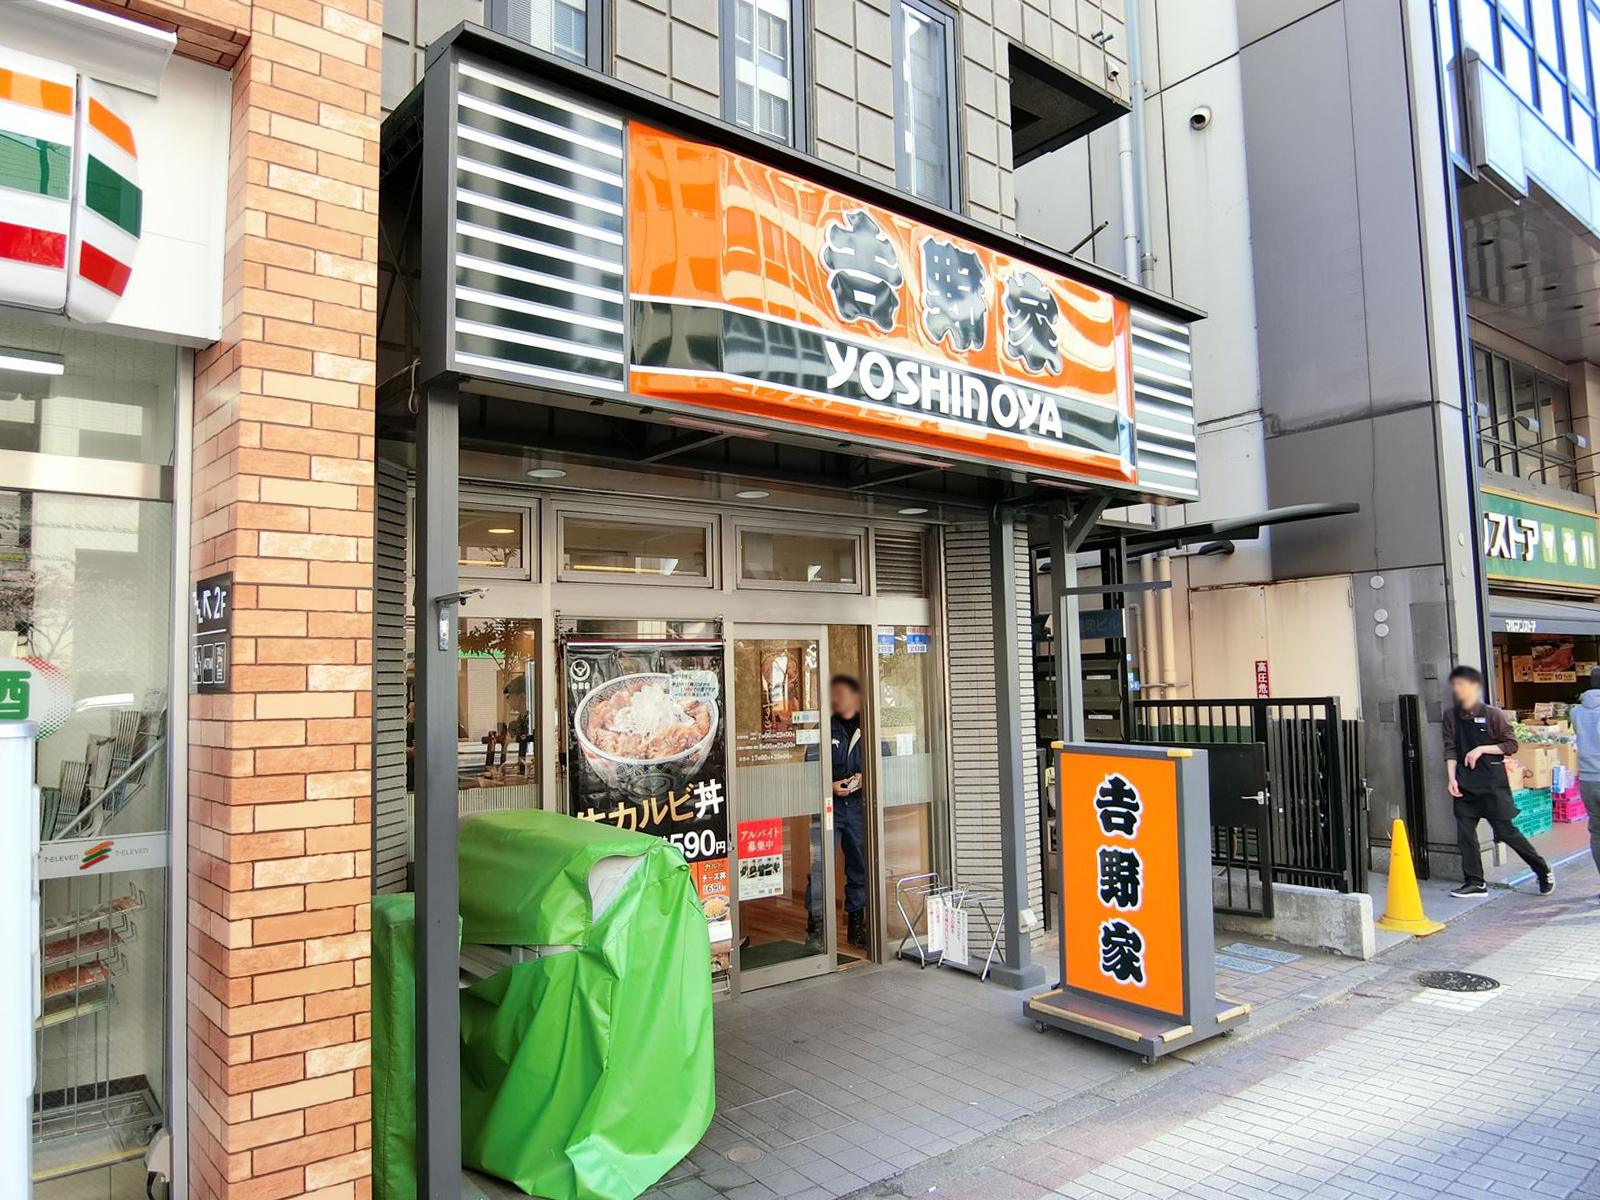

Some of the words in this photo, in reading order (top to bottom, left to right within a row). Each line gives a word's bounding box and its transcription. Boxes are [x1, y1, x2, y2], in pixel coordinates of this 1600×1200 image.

[818, 208, 1064, 376] 吉野家
[824, 340, 1063, 439] YOSHINOYA
[214, 586, 227, 619] 2F
[670, 829, 726, 859] 590円
[740, 827, 780, 842] アルバイト
[747, 840, 774, 853] 募集中
[1093, 773, 1147, 987] 吉野家
